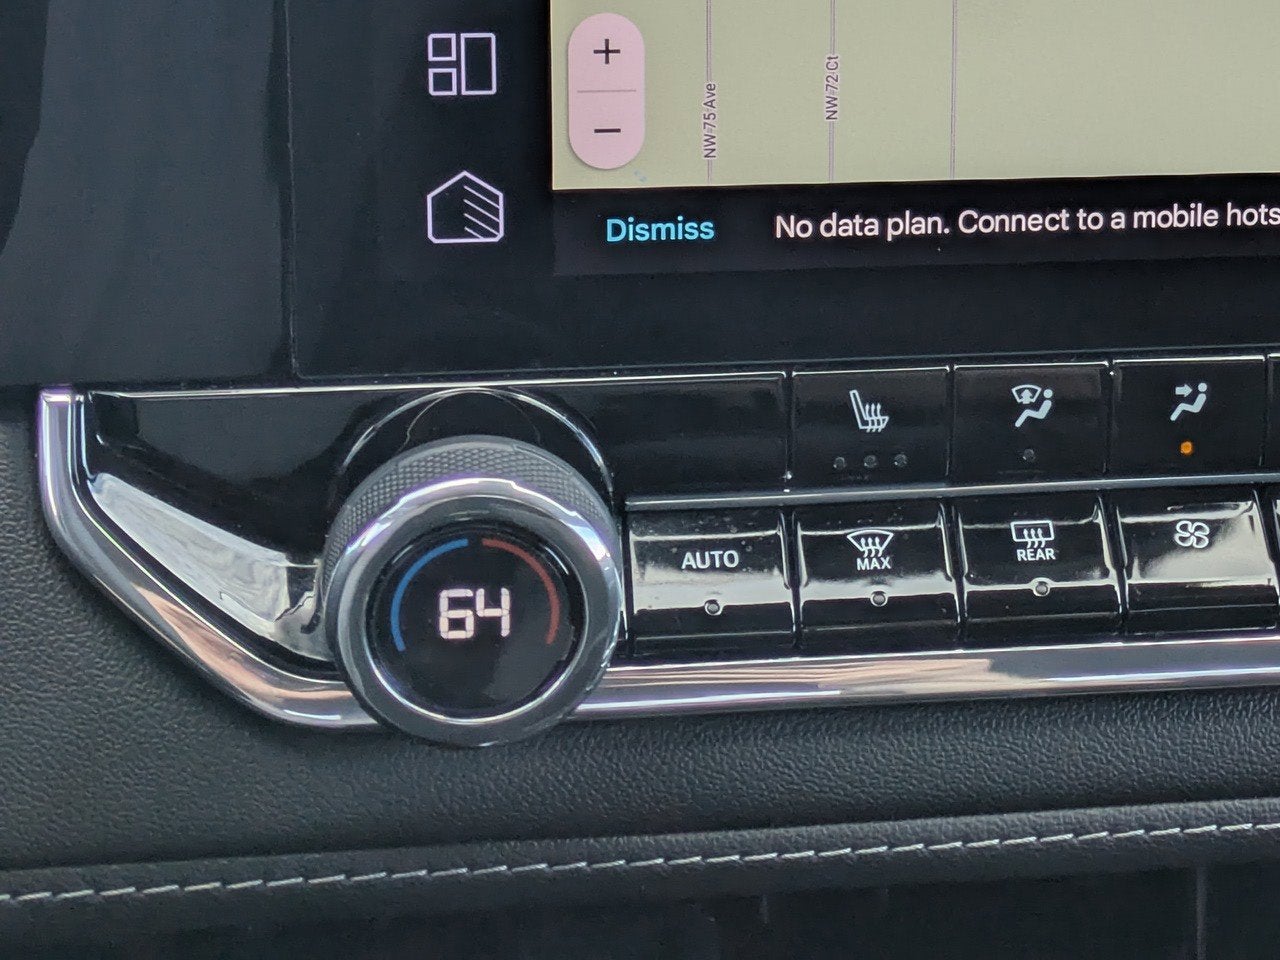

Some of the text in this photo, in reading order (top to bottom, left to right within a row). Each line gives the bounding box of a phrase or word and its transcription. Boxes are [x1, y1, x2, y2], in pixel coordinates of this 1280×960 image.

[826, 56, 838, 120] NW 72 Ct
[704, 83, 716, 159] NW 75 Ave
[606, 215, 715, 242] Dismiss
[775, 214, 813, 239] No
[819, 212, 879, 237] data
[887, 210, 950, 242] plan.
[958, 208, 1069, 234] Connect
[1077, 208, 1104, 230] to
[1110, 212, 1126, 230] a
[1133, 202, 1219, 229] mobile
[681, 550, 739, 570] AUTO
[856, 556, 892, 571] MAX
[1016, 548, 1056, 562] REAR
[437, 587, 512, 640] 64
